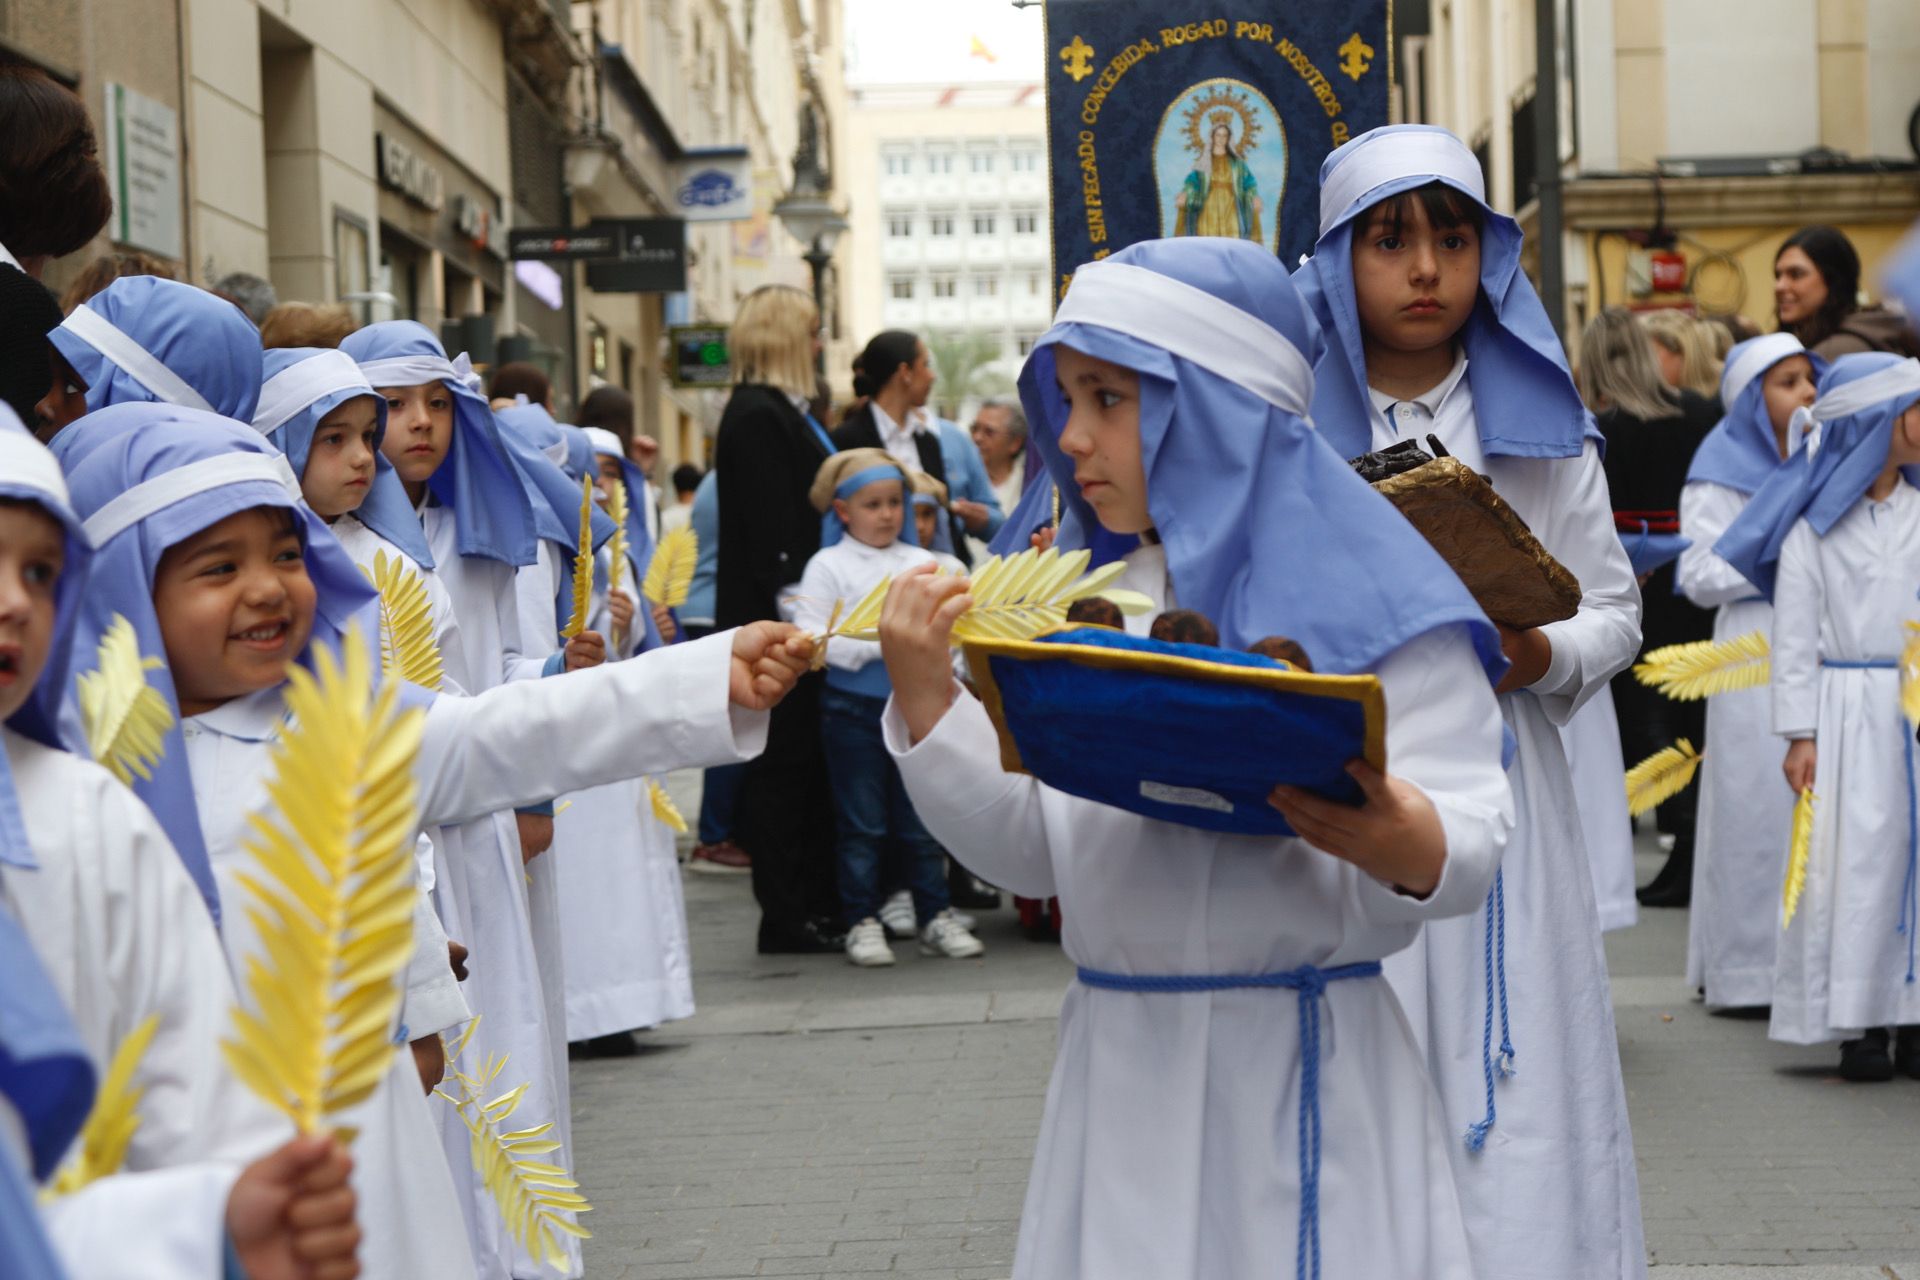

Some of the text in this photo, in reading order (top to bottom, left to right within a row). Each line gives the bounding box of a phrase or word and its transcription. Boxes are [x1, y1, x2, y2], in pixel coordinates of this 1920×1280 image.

[1159, 18, 1228, 48] ROGAD
[1235, 21, 1273, 44] POR
[1275, 38, 1342, 117] NOSOTROS
[1078, 130, 1102, 206] PECADO
[1086, 208, 1107, 243] SIN
